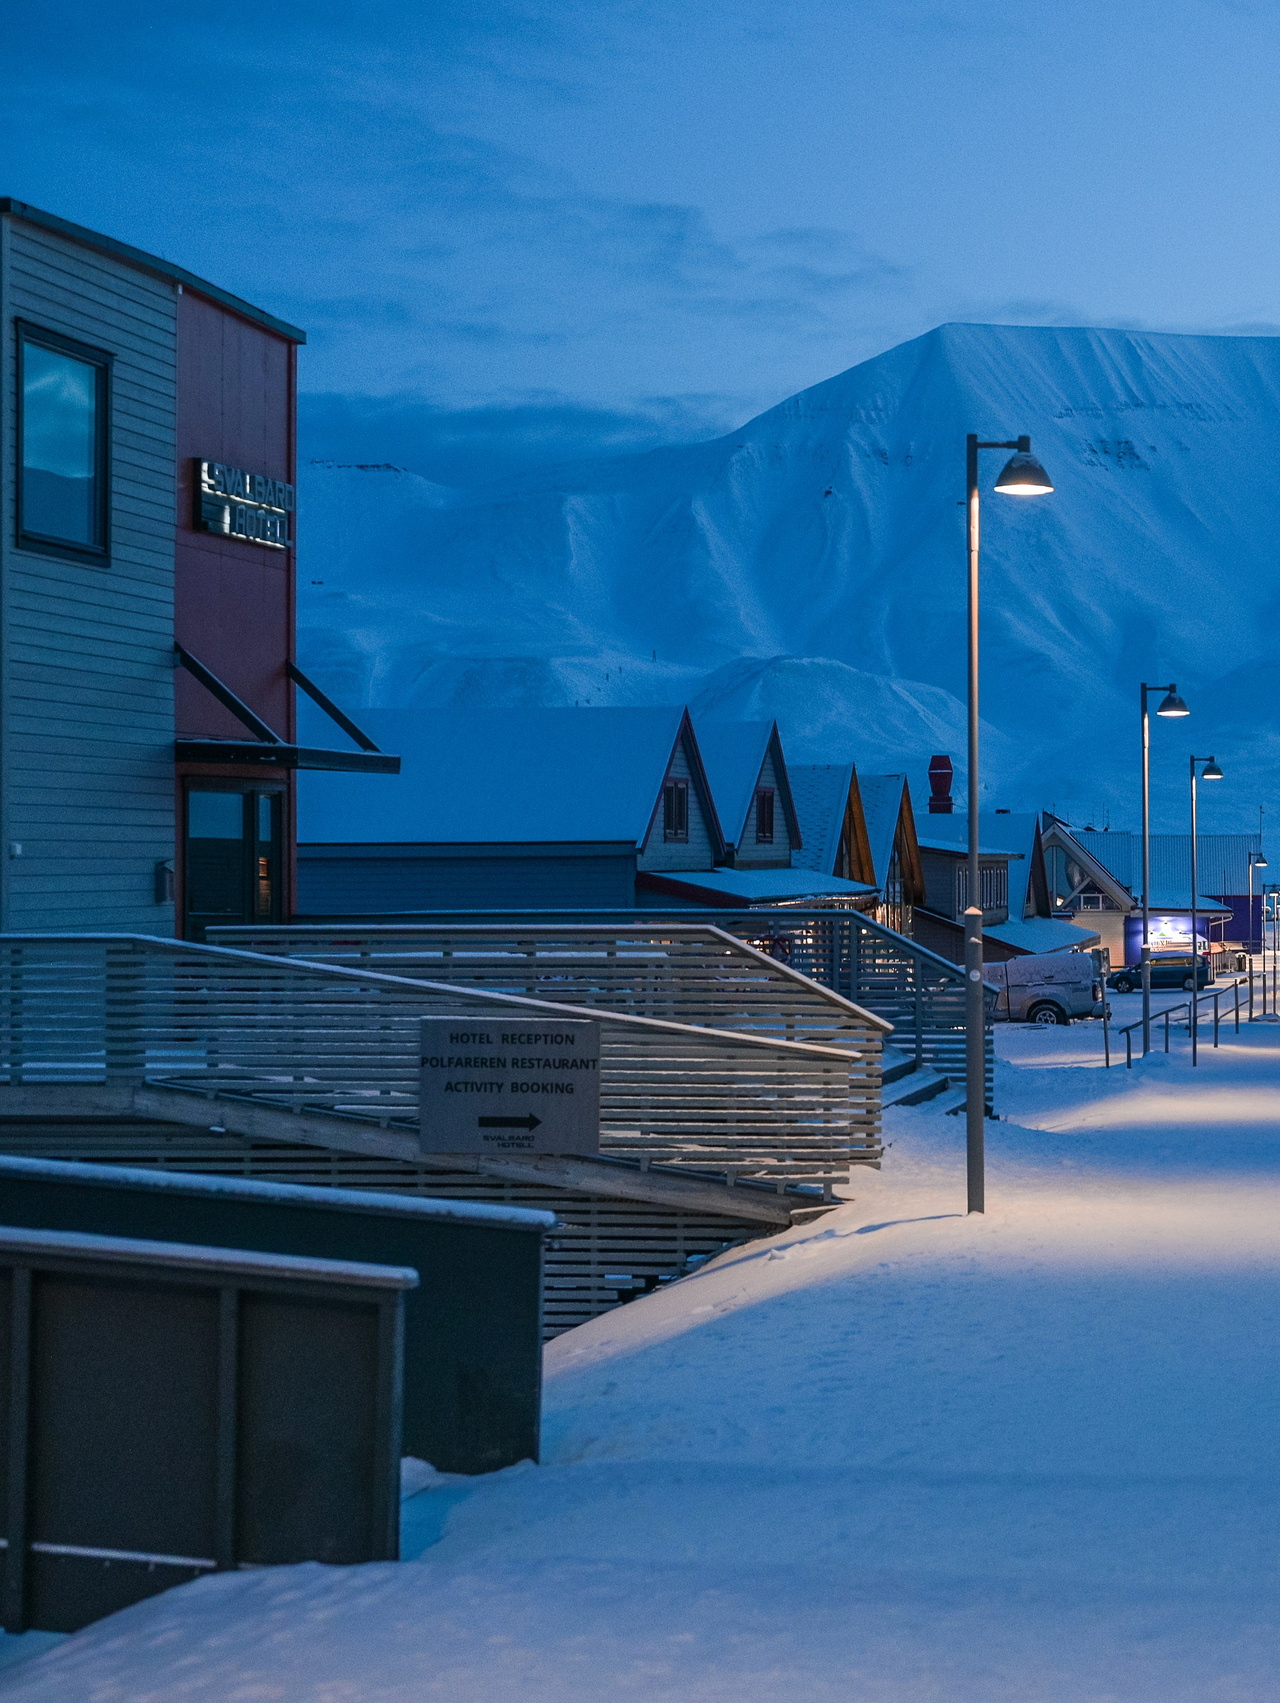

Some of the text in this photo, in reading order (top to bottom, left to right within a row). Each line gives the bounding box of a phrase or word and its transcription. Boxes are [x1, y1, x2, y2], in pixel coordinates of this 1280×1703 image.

[201, 462, 294, 511] SVALBARD
[449, 1032, 576, 1046] HOTEL RECEPTION
[421, 1056, 599, 1070] POLFAREREN RESTAURANT
[444, 1081, 575, 1095] ACTIVITY BOOKING
